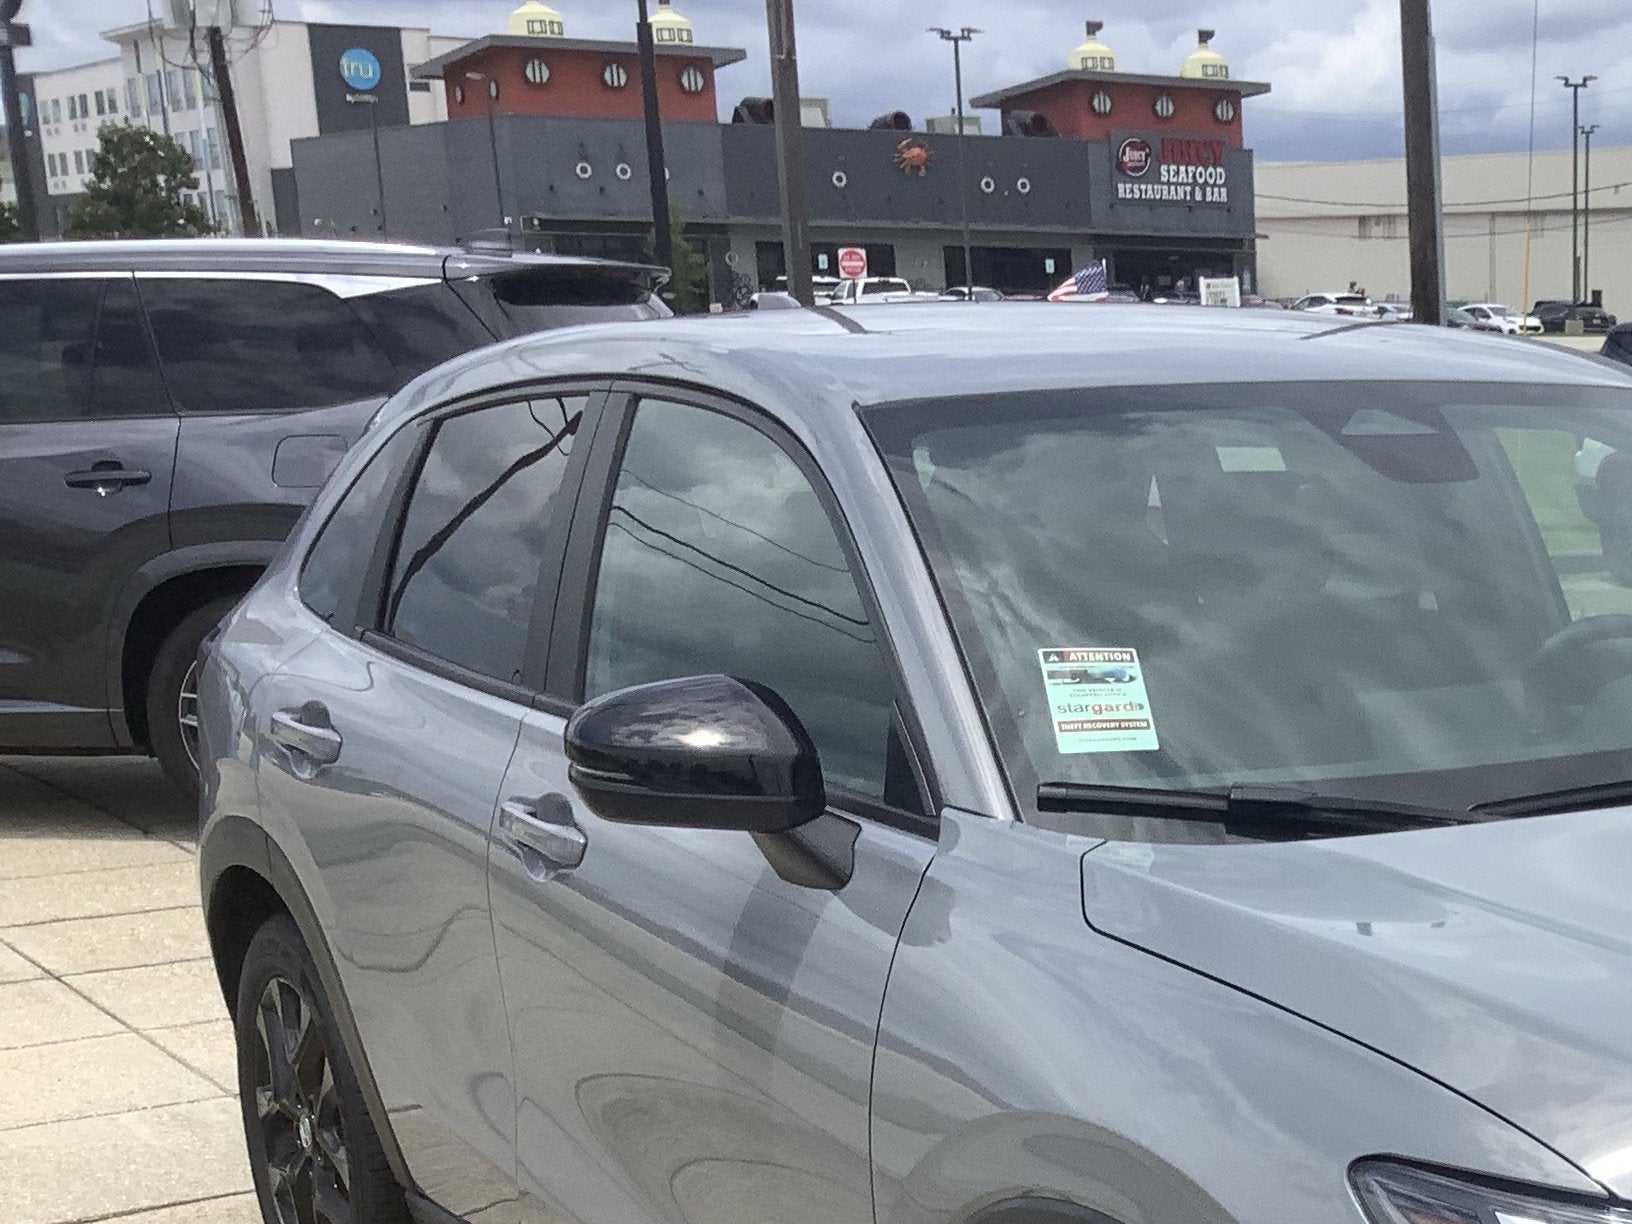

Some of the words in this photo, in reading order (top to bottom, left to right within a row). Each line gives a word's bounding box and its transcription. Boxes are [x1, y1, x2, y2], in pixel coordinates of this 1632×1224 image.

[1160, 164, 1226, 185] SEAFOOD
[1117, 183, 1192, 201] RESTAURANT
[1205, 186, 1228, 203] BAR
[1069, 652, 1131, 662] ATTENTION
[1083, 721, 1120, 730] RECOVERY
[1120, 720, 1148, 729] SYSTEM
